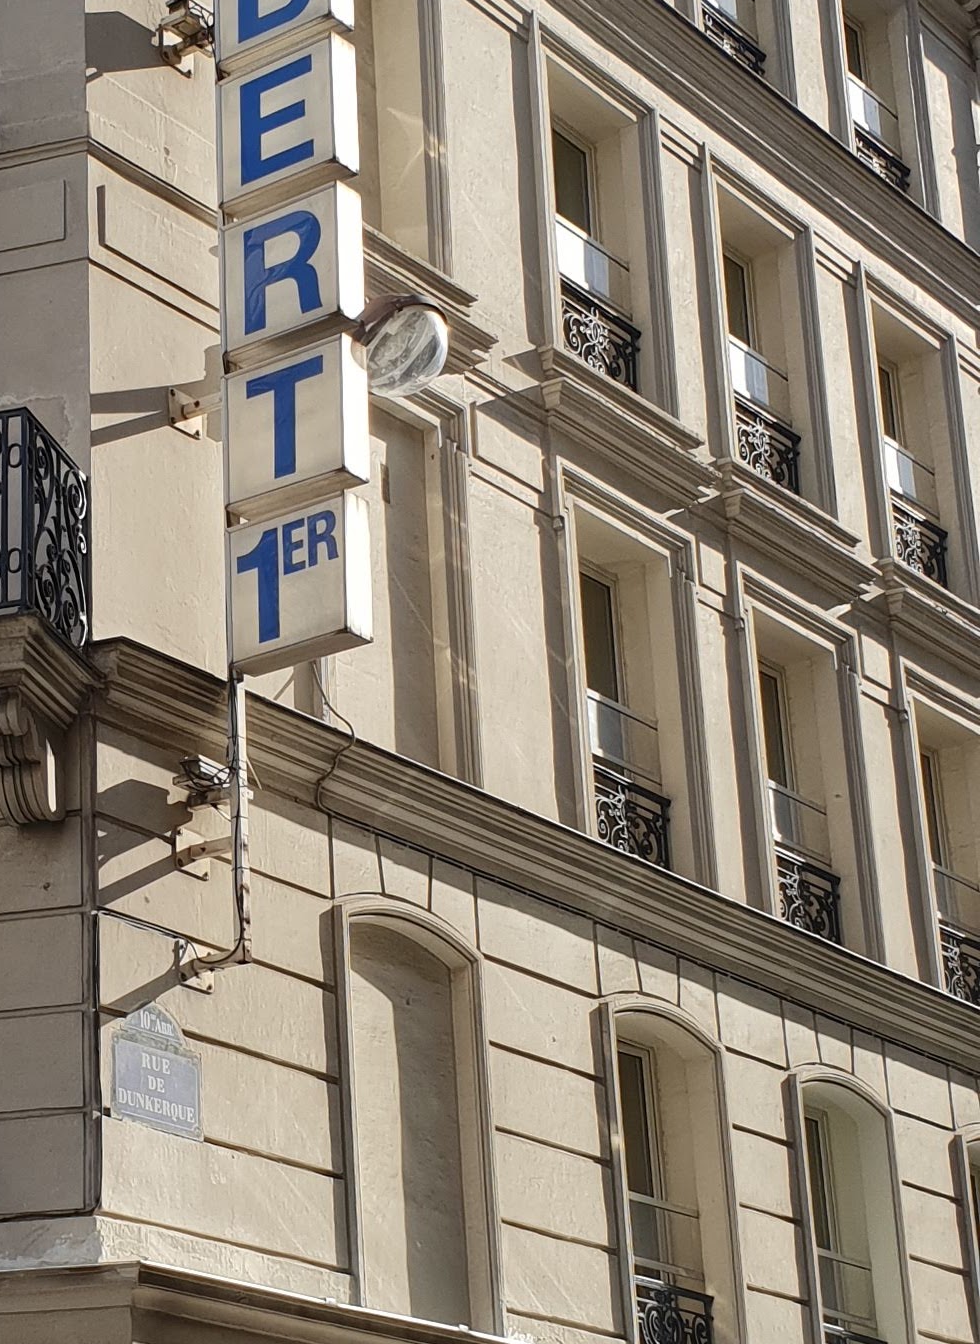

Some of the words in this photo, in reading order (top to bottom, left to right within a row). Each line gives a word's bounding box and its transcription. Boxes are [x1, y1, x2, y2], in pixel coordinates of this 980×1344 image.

[237, 510, 339, 644] 1ER
[141, 1052, 170, 1075] RUE
[148, 1075, 165, 1093] DE
[118, 1088, 195, 1123] DUNKERQUE
